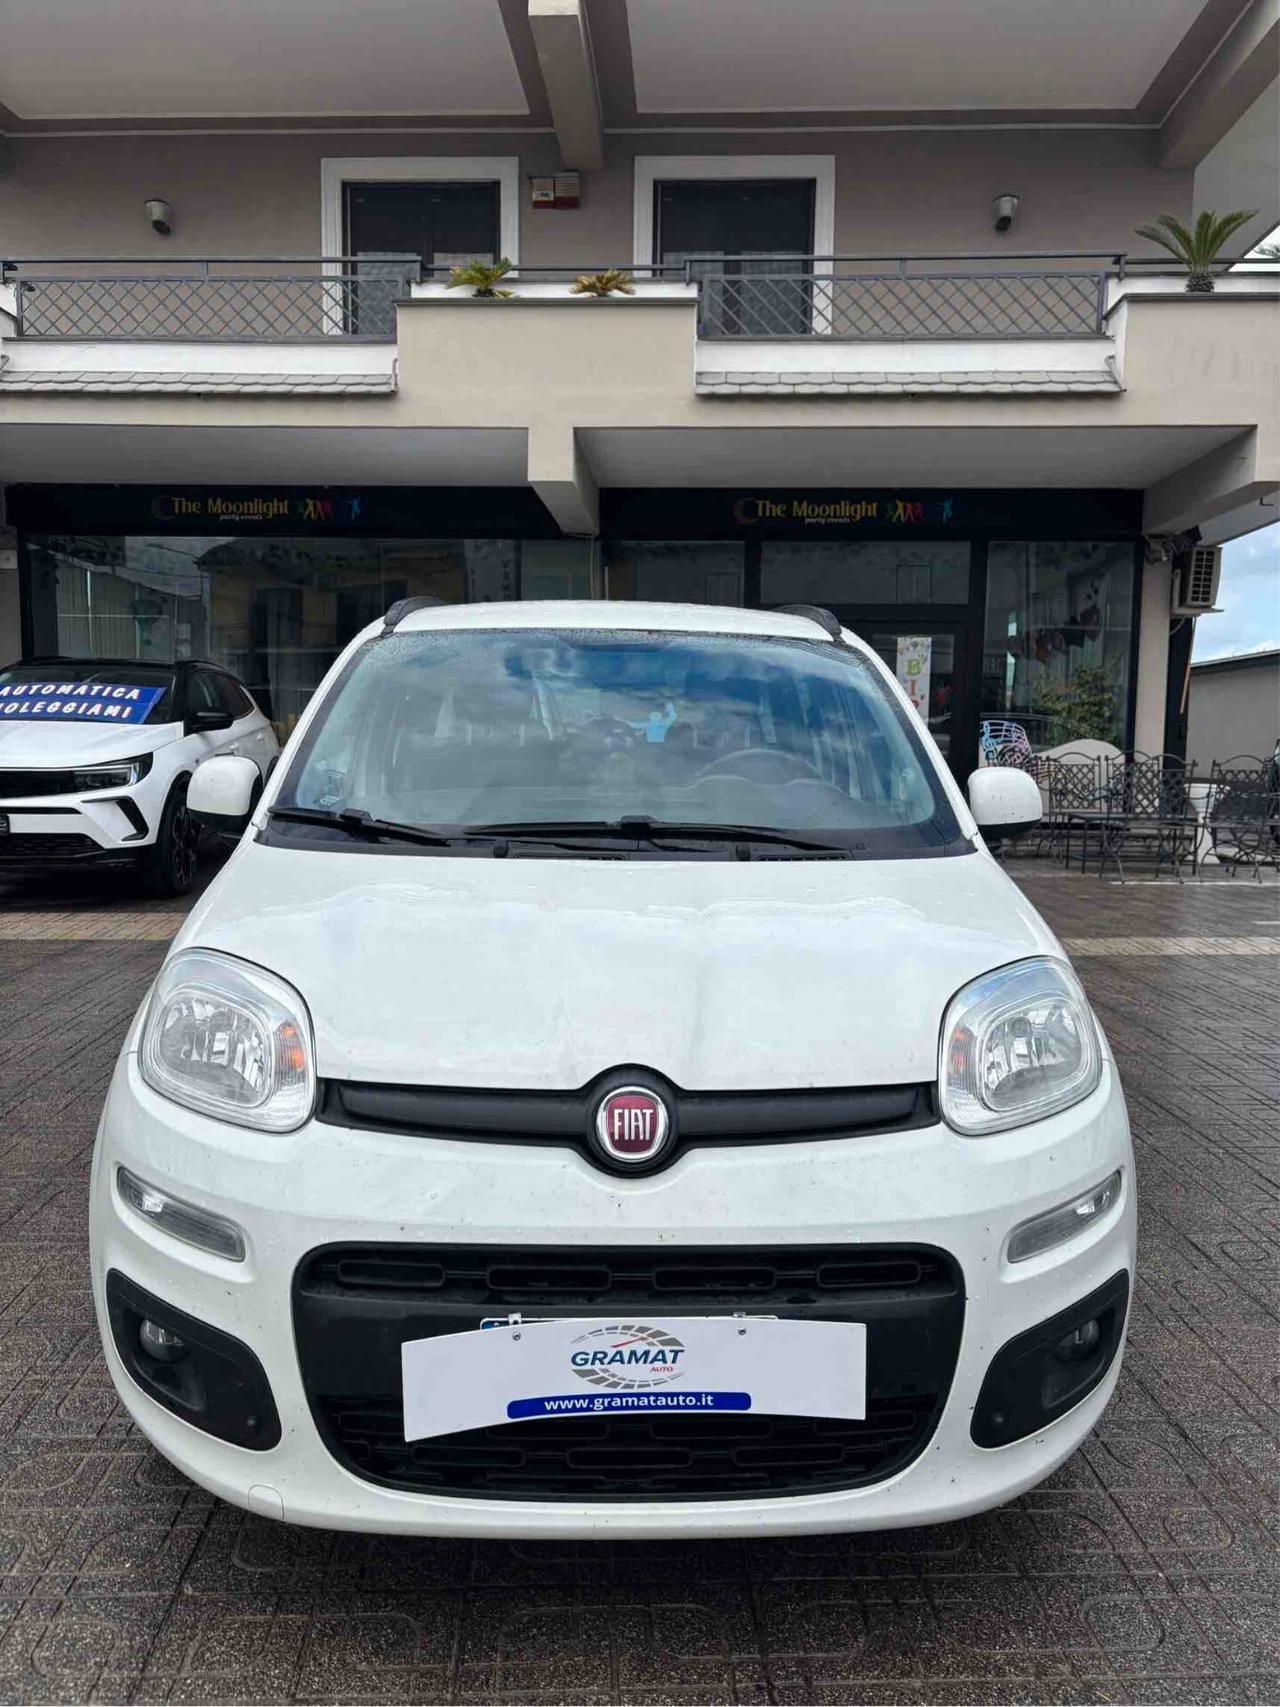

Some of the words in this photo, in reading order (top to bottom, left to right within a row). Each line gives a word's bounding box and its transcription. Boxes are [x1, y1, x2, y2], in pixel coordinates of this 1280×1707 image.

[172, 498, 201, 514] The
[207, 498, 289, 518] Moonlight
[755, 500, 786, 517] The
[792, 500, 878, 521] Moonlight
[219, 513, 240, 522] party
[804, 517, 827, 525] party
[0, 684, 140, 700] AUTOMATICA
[0, 701, 132, 719] OLEGGIAMI
[614, 1108, 654, 1141] FIAT
[571, 1349, 685, 1367] GRAMAT
[544, 1393, 714, 1411] www.gramatauto.it
